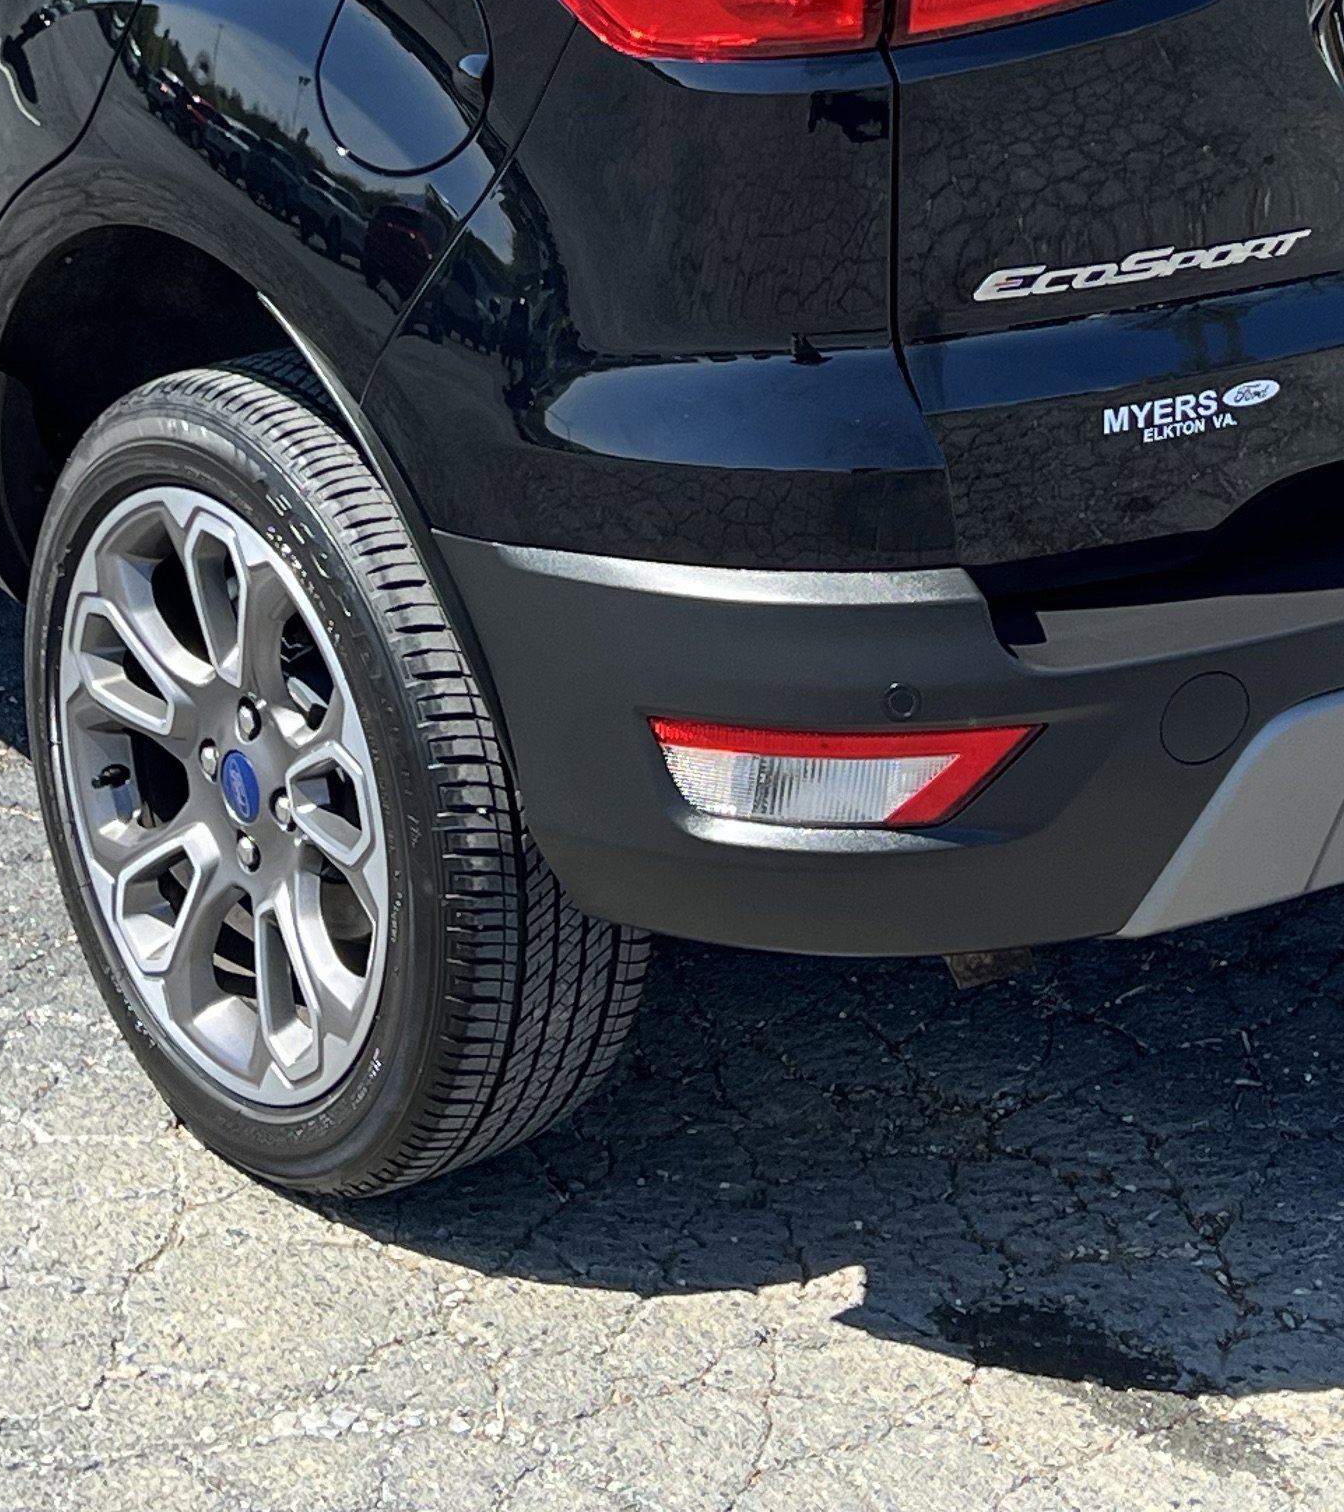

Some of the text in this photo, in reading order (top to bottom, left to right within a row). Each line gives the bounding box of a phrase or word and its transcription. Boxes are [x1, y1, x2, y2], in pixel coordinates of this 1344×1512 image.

[1103, 390, 1218, 435] MYERS
[1142, 412, 1238, 444] ELKTON VA.
